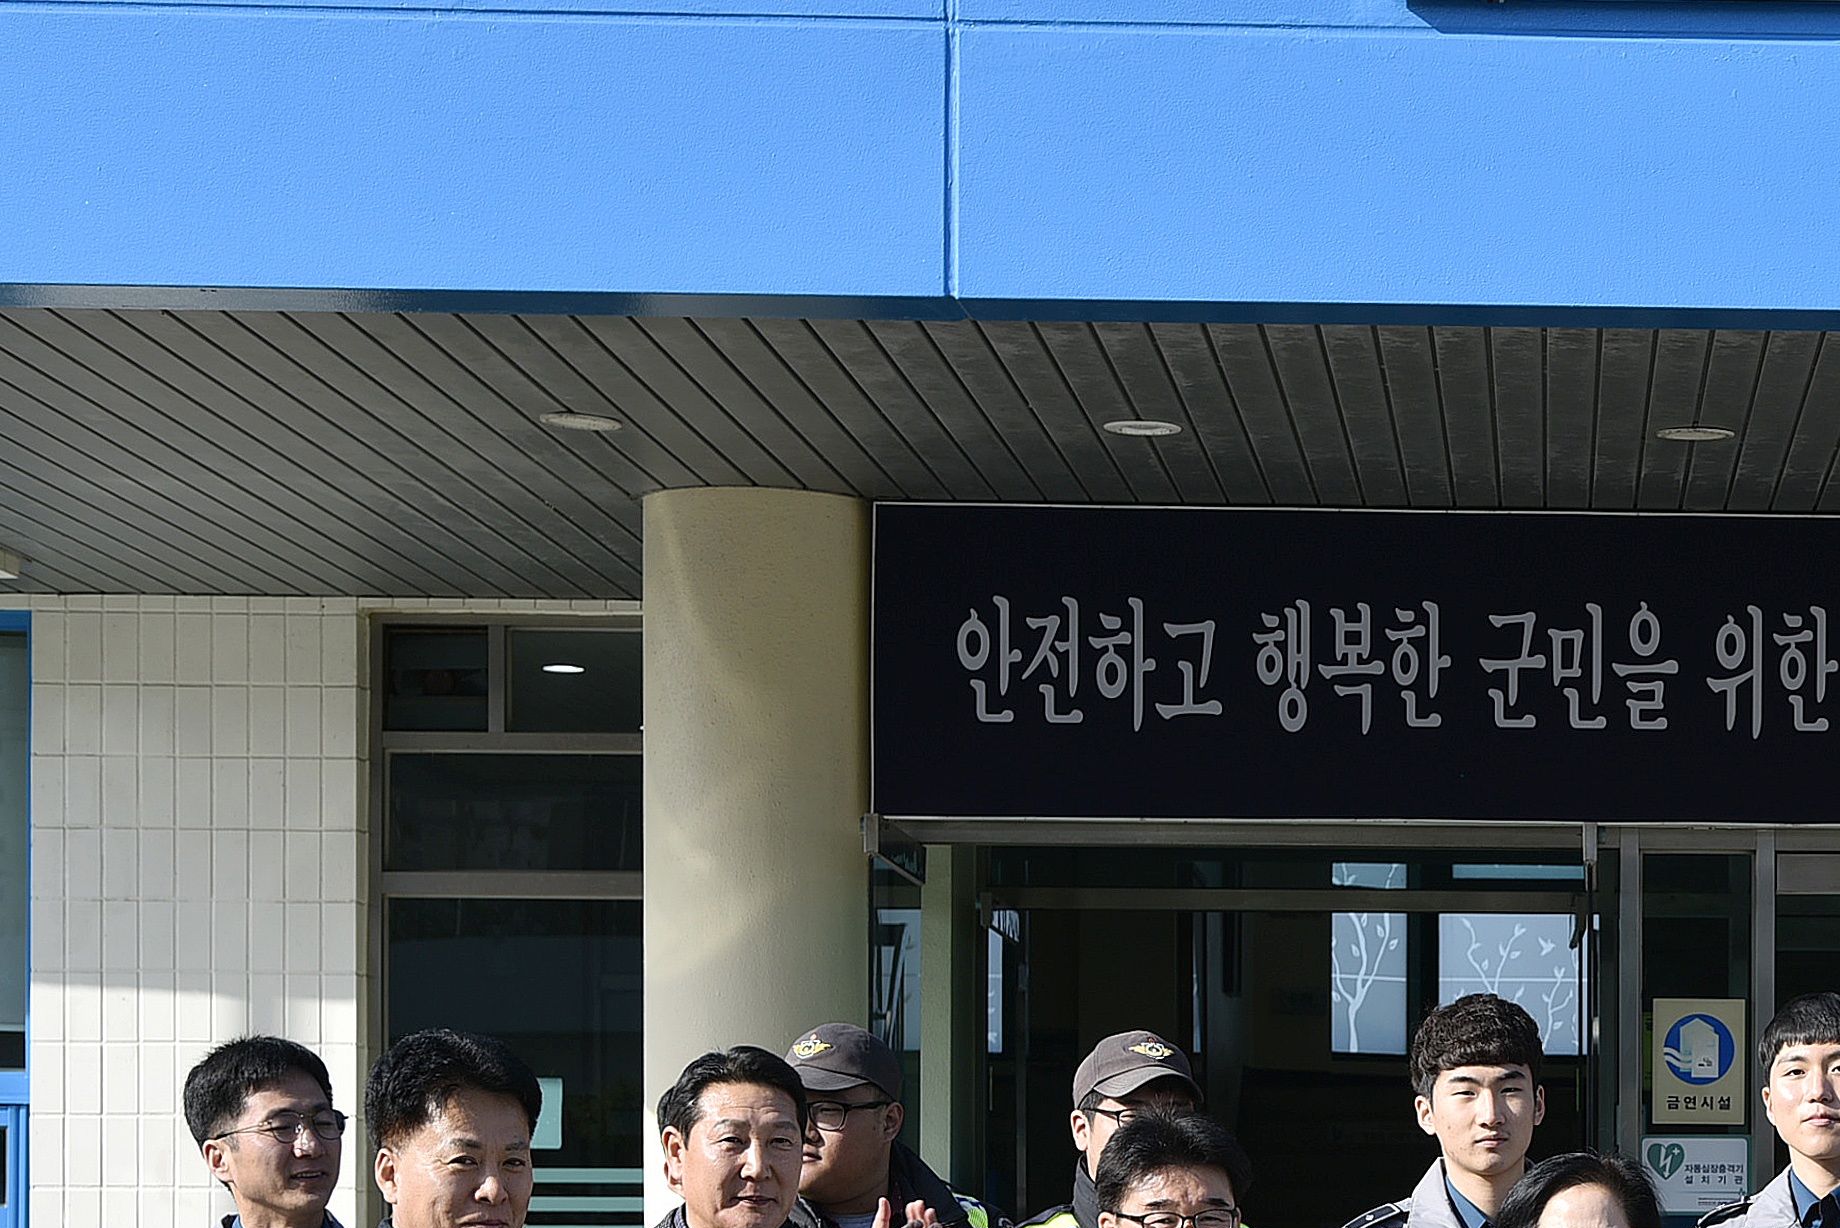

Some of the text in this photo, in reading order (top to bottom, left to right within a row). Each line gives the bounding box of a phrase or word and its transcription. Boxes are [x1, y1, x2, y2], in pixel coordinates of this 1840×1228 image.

[956, 595, 1223, 732] 안전하고
[1252, 599, 1452, 735] 행복한
[1478, 601, 1680, 731] 군민을
[1706, 604, 1839, 740] 위한
[1666, 1095, 1731, 1111] 금연시설
